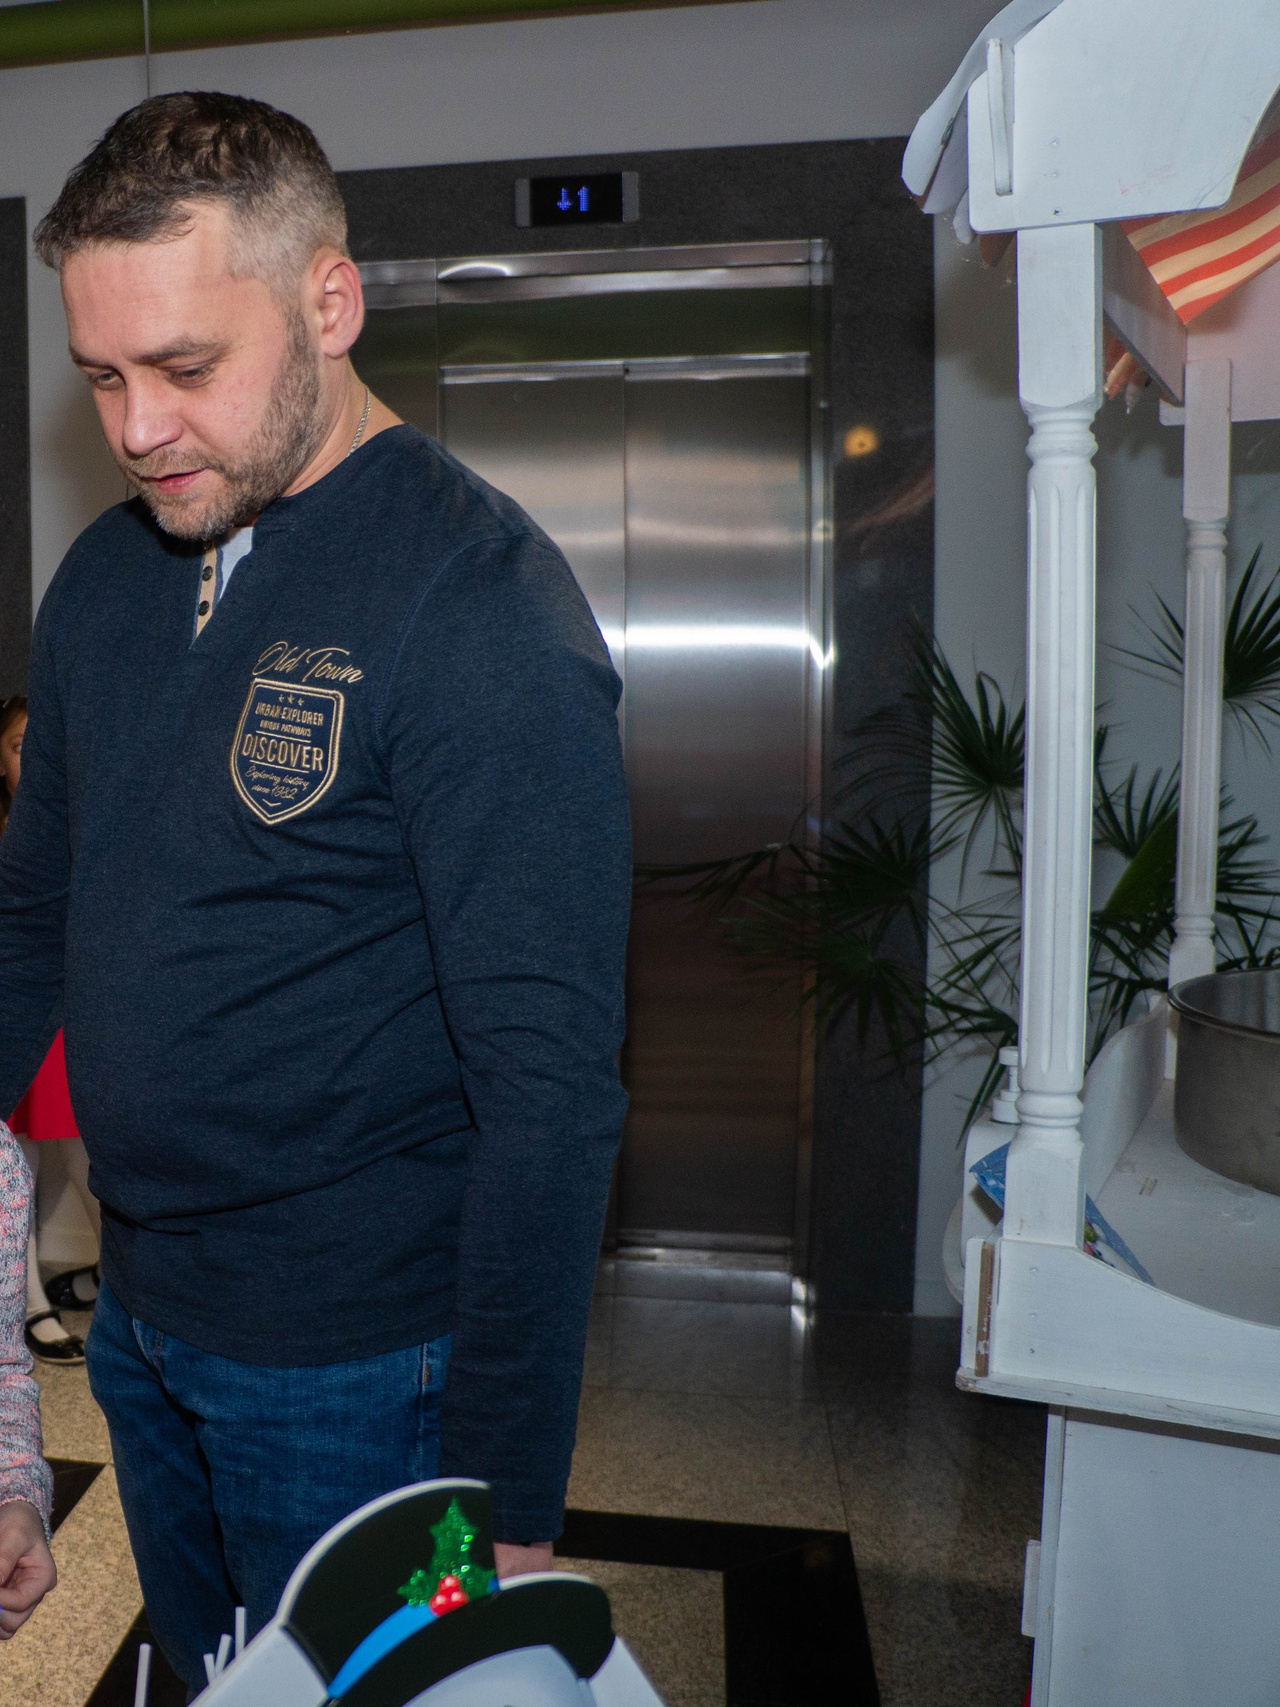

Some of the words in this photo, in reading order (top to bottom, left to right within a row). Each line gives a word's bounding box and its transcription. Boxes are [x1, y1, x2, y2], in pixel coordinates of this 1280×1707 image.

[578, 185, 590, 212] 1
[252, 641, 310, 676] Old
[301, 647, 365, 683] Town
[281, 707, 324, 726] EXPLORER
[242, 733, 324, 771] DISCOVER
